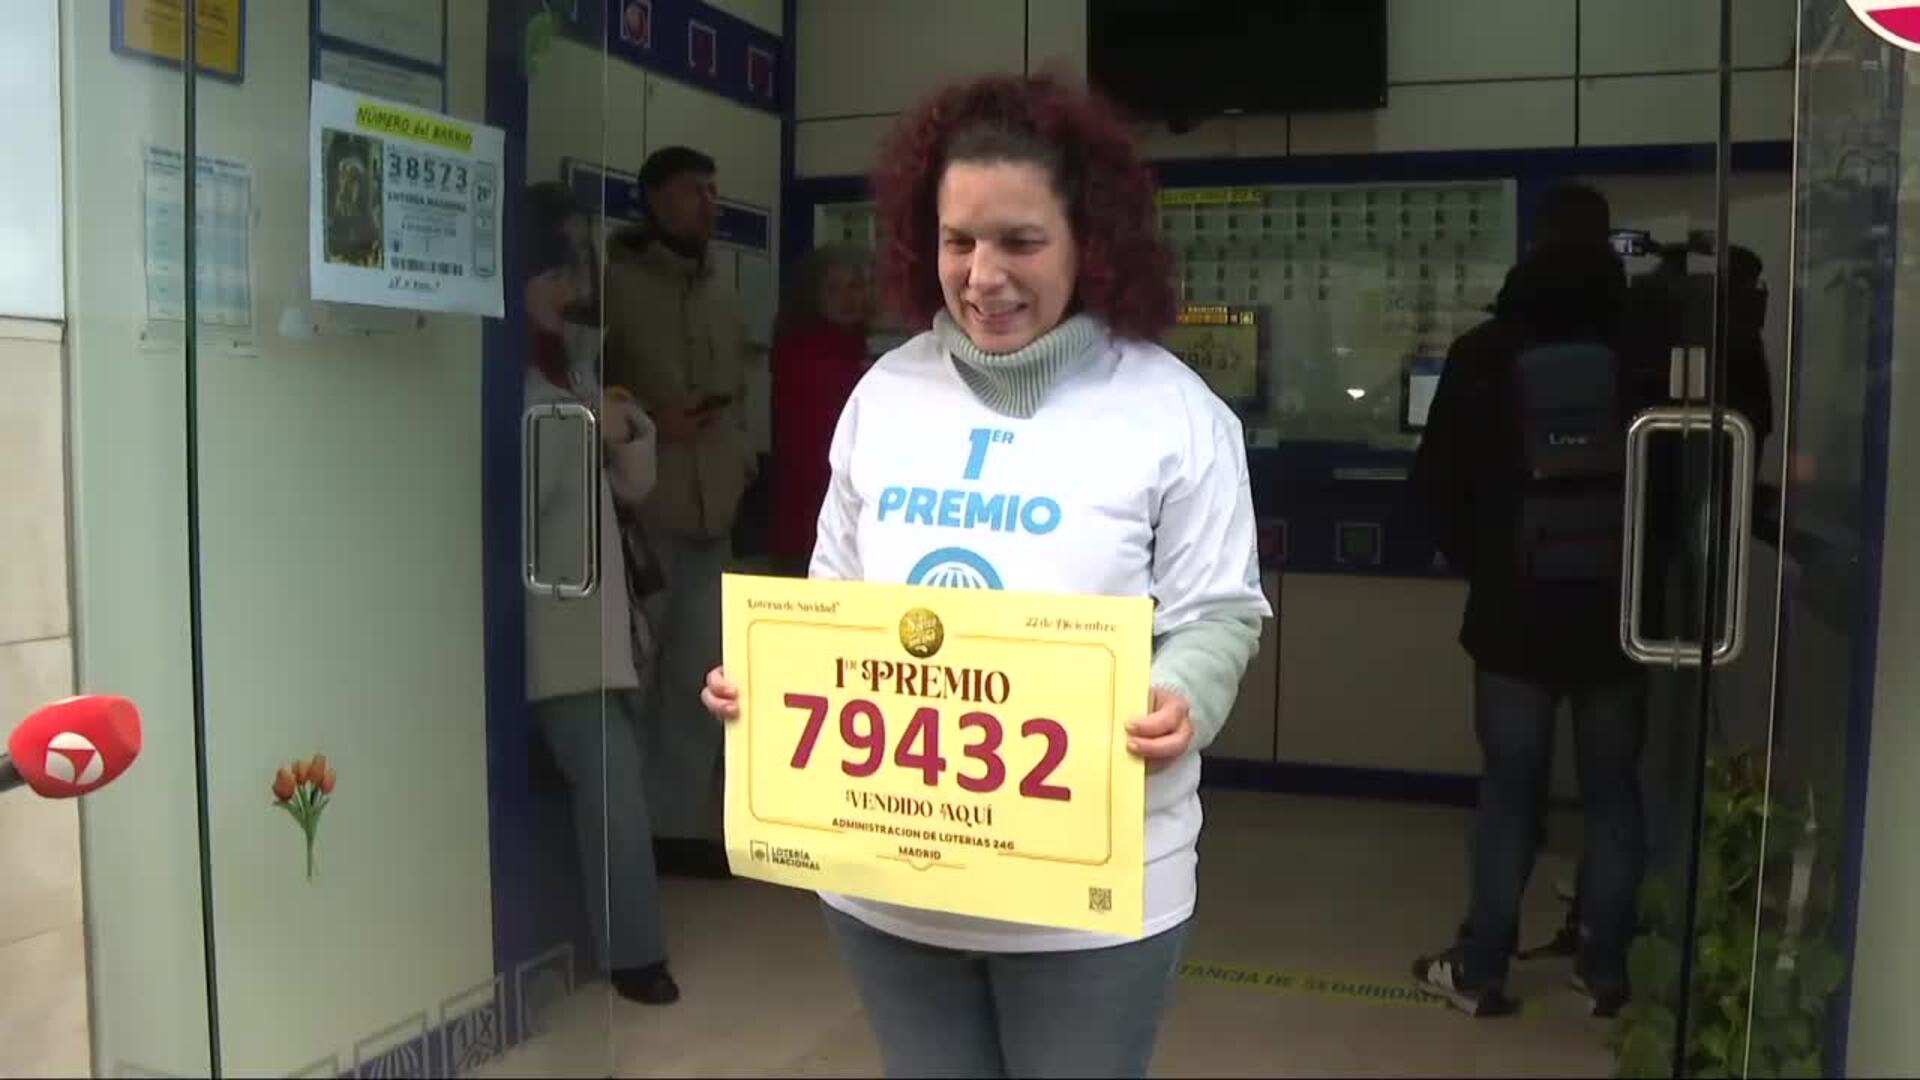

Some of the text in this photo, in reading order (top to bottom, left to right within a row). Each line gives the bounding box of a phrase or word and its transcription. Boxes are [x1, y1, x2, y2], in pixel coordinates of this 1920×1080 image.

[387, 153, 468, 190] 38573
[878, 487, 1061, 535] PREMIO
[1026, 616, 1039, 627] 22
[861, 659, 1010, 705] PREMIO
[783, 692, 1072, 802] 79432
[845, 789, 993, 827] VENDIDO AQUÍ
[832, 818, 1015, 851] ADMINISTRACION DE LOTERIAS 246
[771, 856, 821, 871] NACIONAL
[898, 845, 941, 861] MADRID
[1265, 974, 1297, 988] DE
